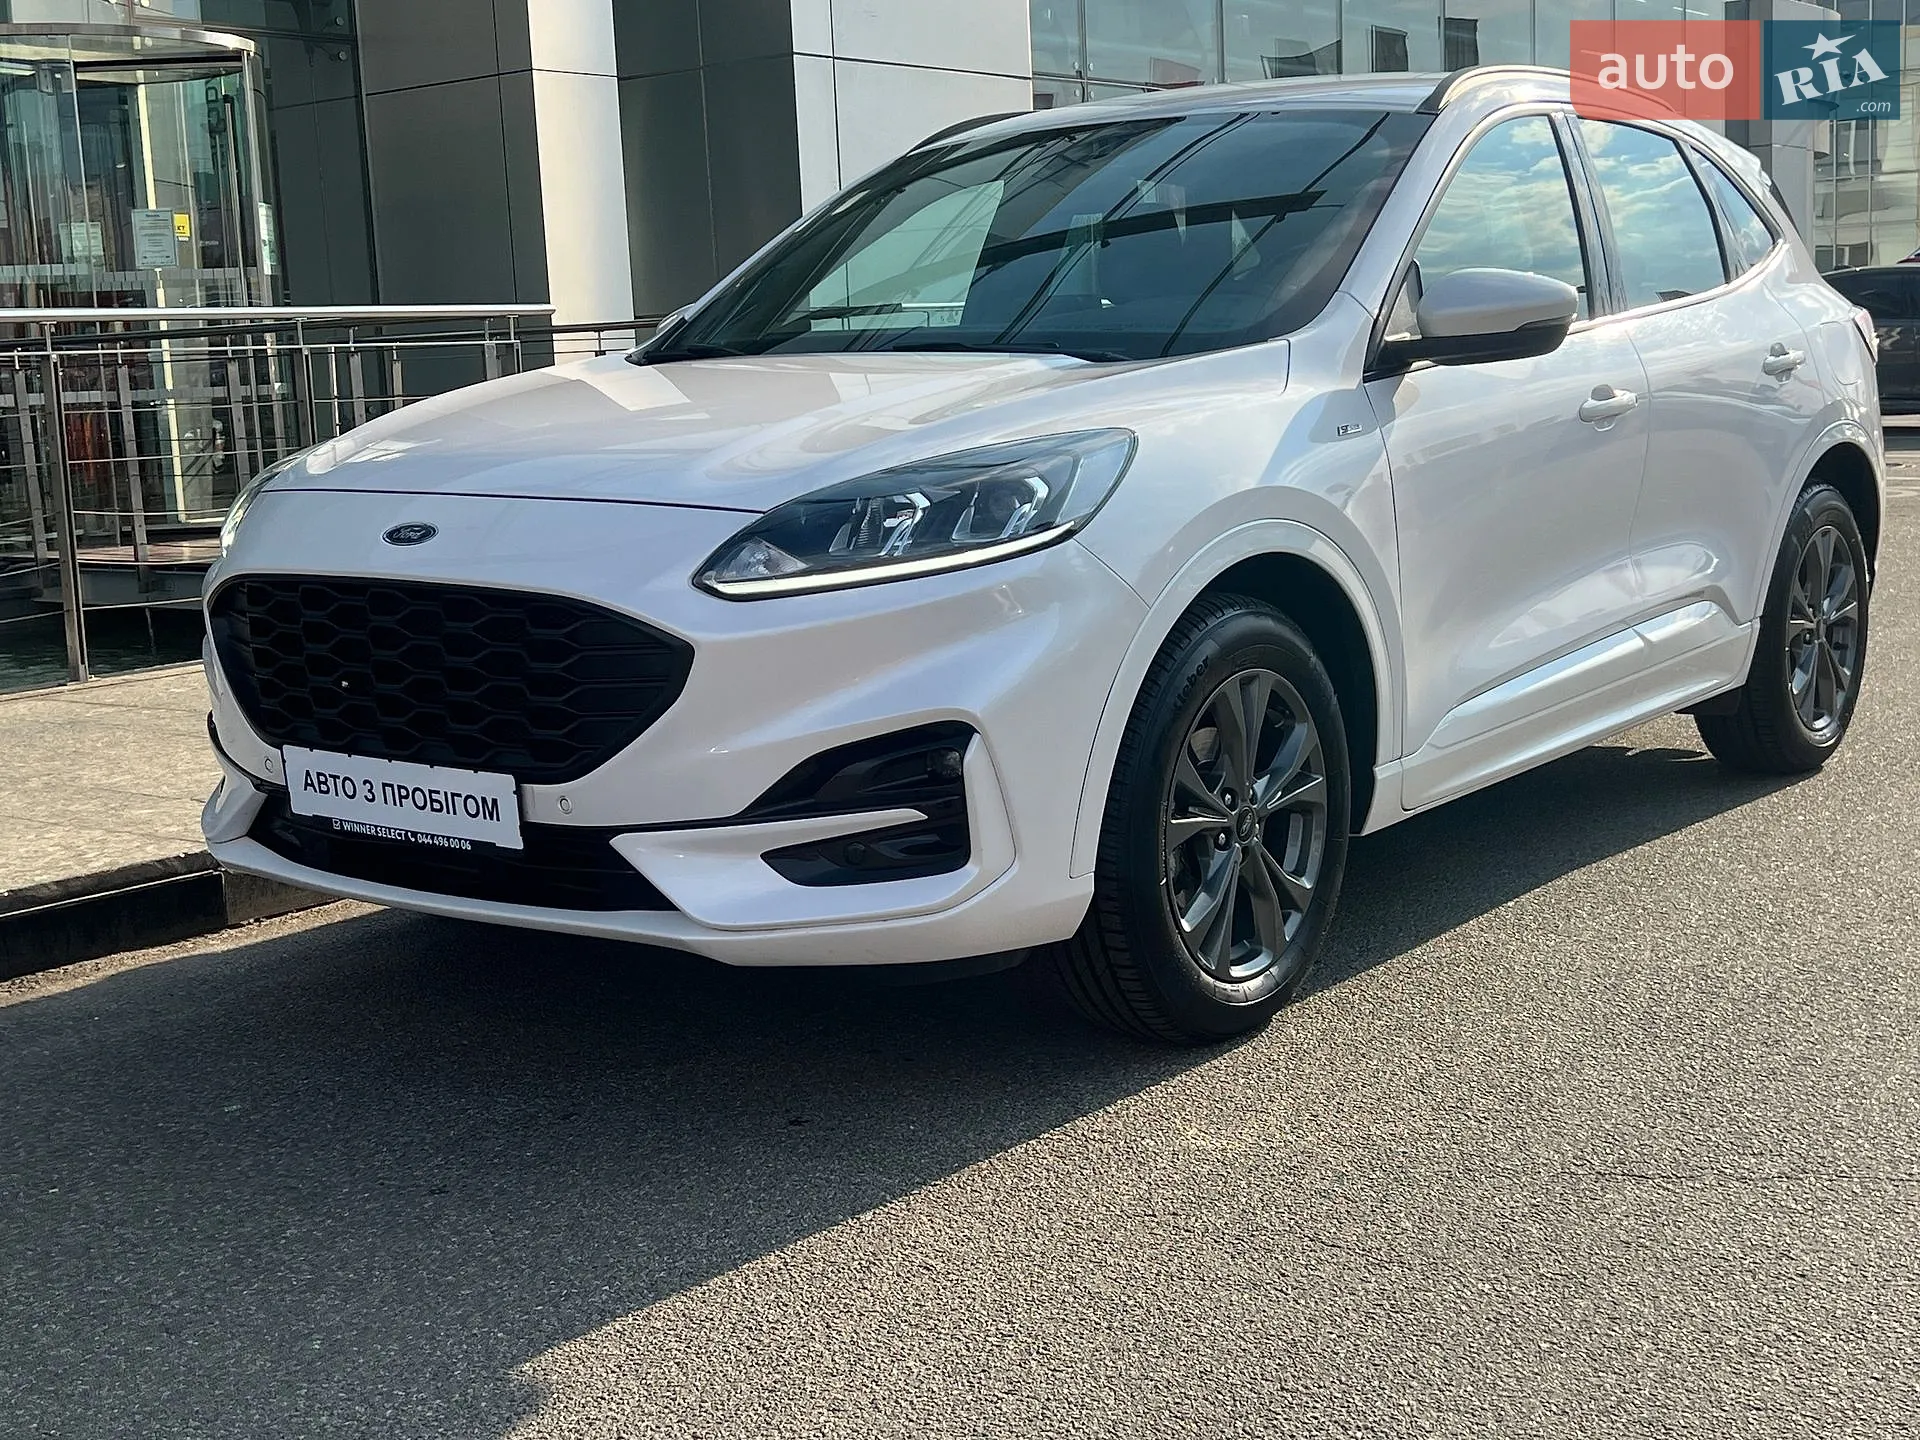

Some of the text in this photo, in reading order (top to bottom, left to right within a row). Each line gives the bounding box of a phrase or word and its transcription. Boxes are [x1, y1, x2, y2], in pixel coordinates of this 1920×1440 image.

[303, 769, 357, 800] АВТО
[381, 781, 501, 822] ПРОБІГОМ
[342, 820, 472, 850] WINNER SELECT 044 496 00 06
